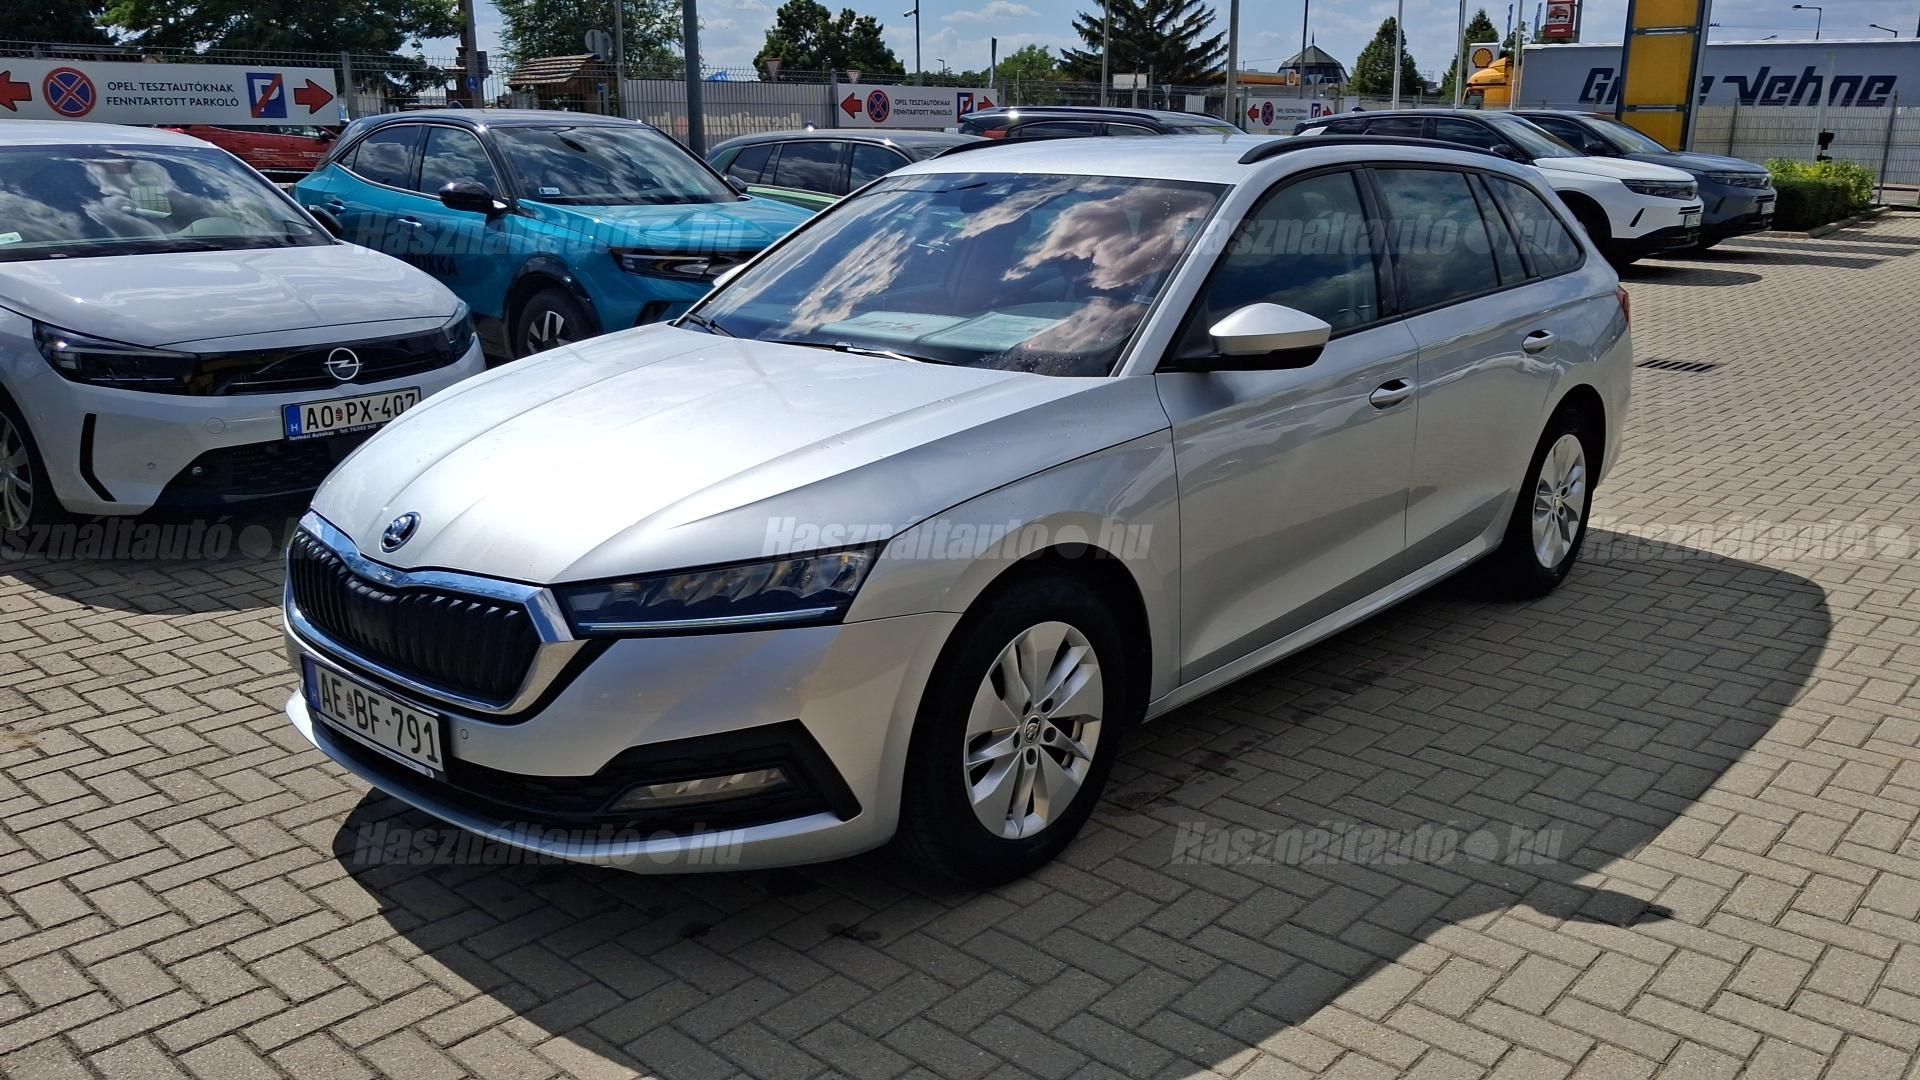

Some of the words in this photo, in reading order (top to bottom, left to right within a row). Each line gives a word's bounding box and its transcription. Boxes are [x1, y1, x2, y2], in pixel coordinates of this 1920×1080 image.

[107, 81, 136, 92] OPEL
[139, 82, 234, 93] TESZTAUTÓKNAK
[1722, 65, 1897, 108] Vehne
[106, 96, 189, 107] FENNTARTOTT
[189, 97, 239, 107] PARKOLÓ
[306, 405, 335, 431] AO
[320, 672, 346, 720] AE
[353, 688, 439, 764] BF-791
